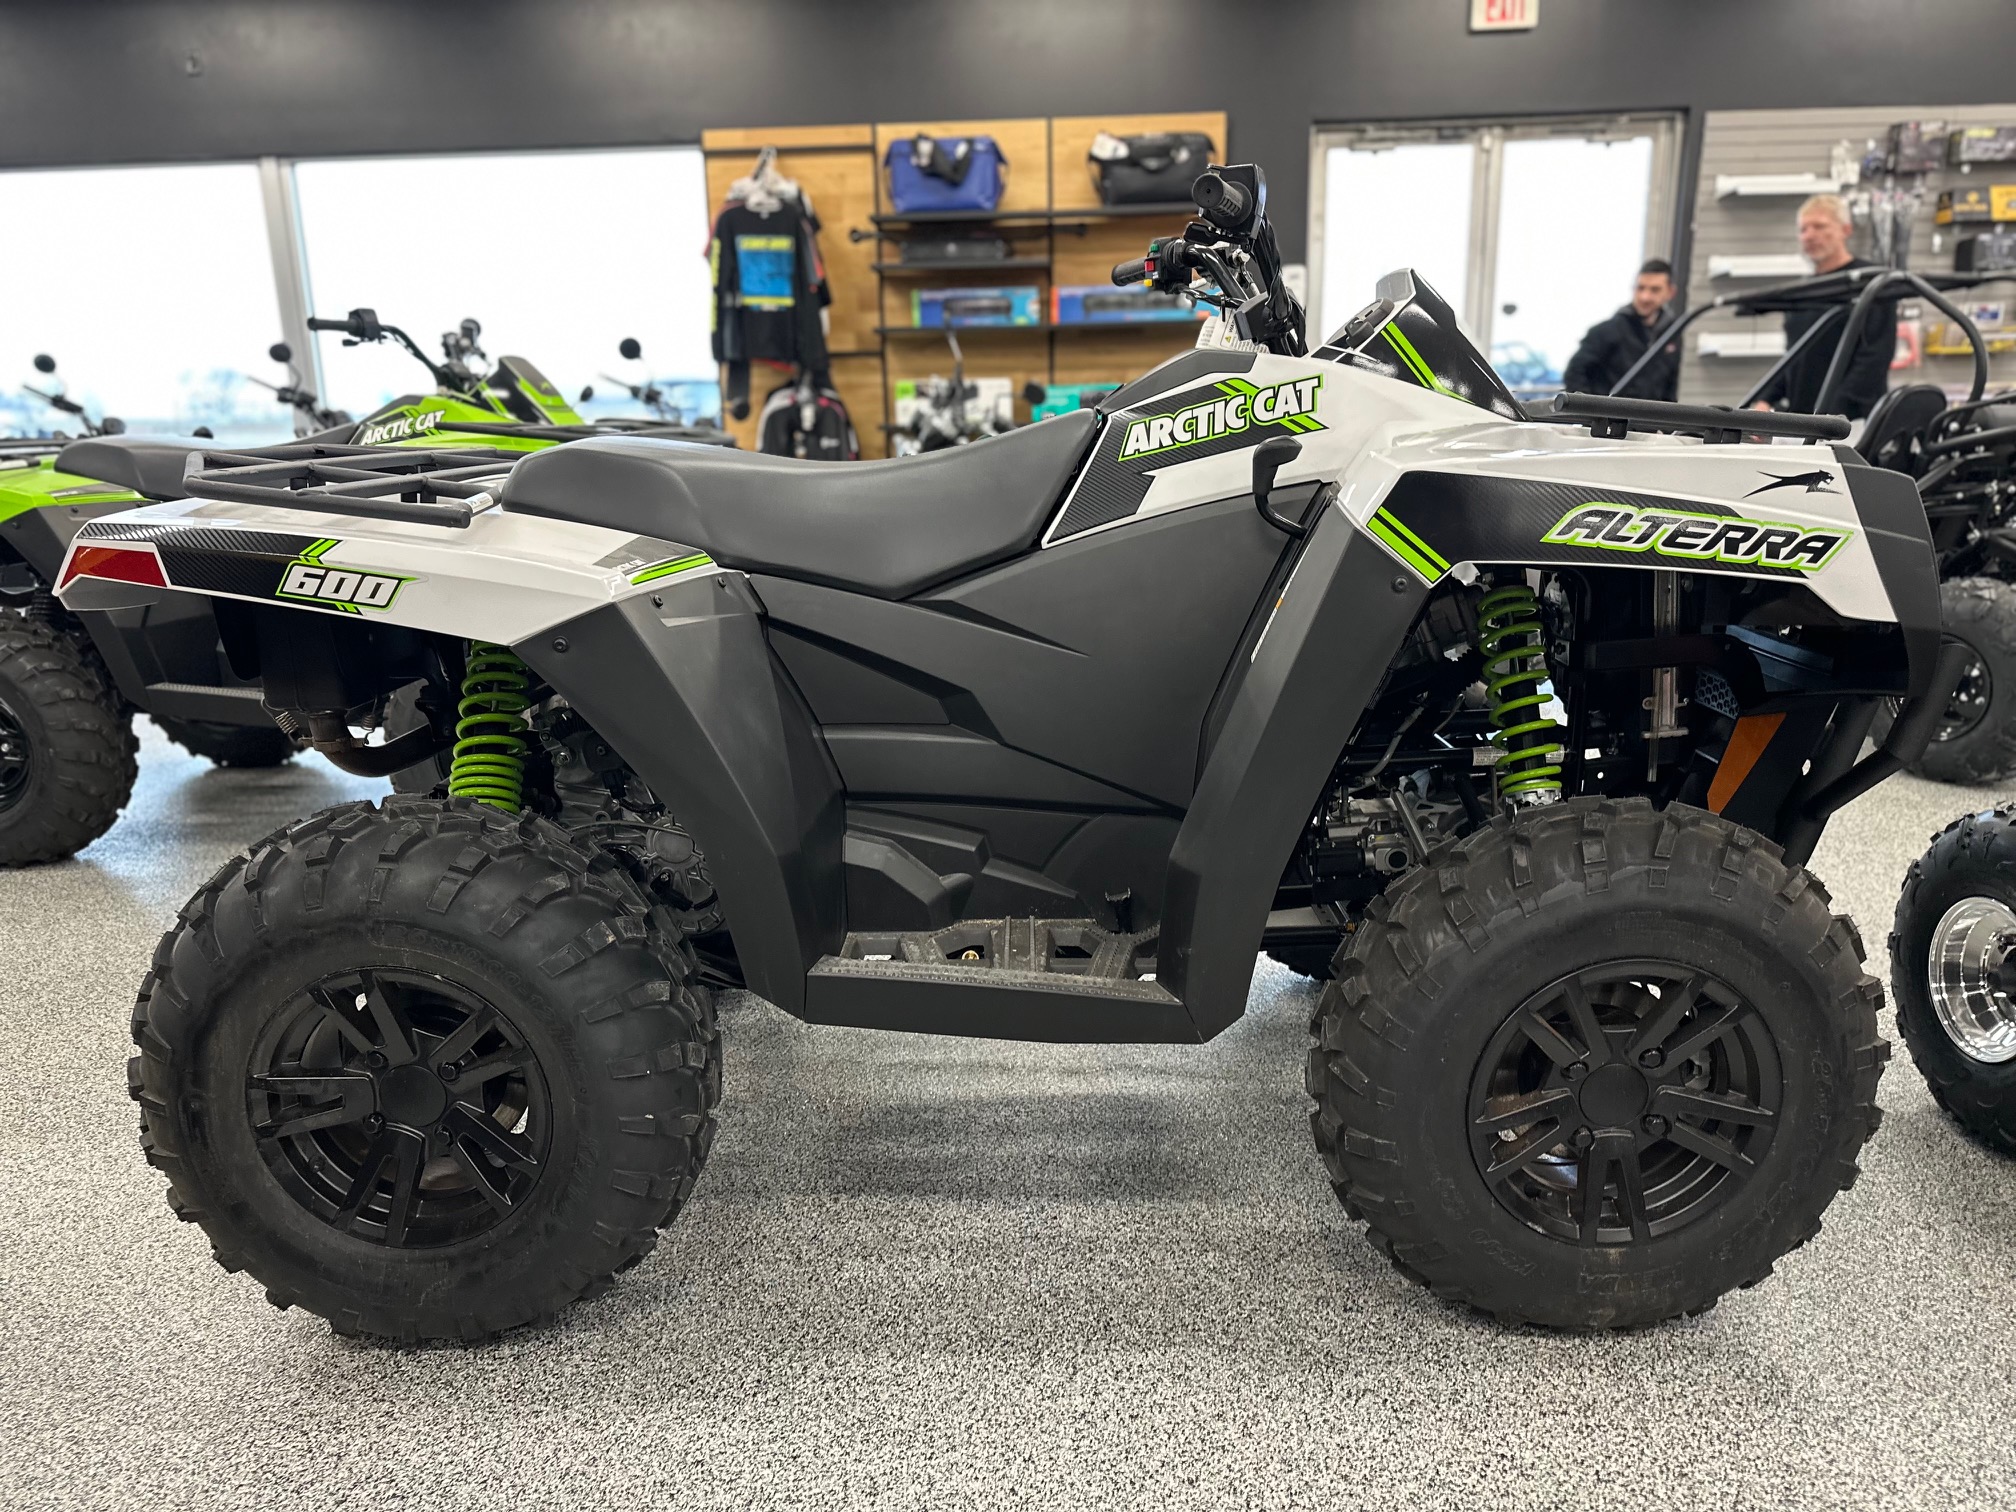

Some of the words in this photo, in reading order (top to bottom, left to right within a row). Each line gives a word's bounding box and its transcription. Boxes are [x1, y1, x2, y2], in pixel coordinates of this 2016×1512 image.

[360, 417, 414, 446] ARCTIC
[415, 409, 446, 432] CAT
[1121, 394, 1249, 458] ARCTIC
[1251, 374, 1323, 423] CAT
[1550, 507, 1846, 567] ALTERRA
[281, 563, 400, 607] 600
